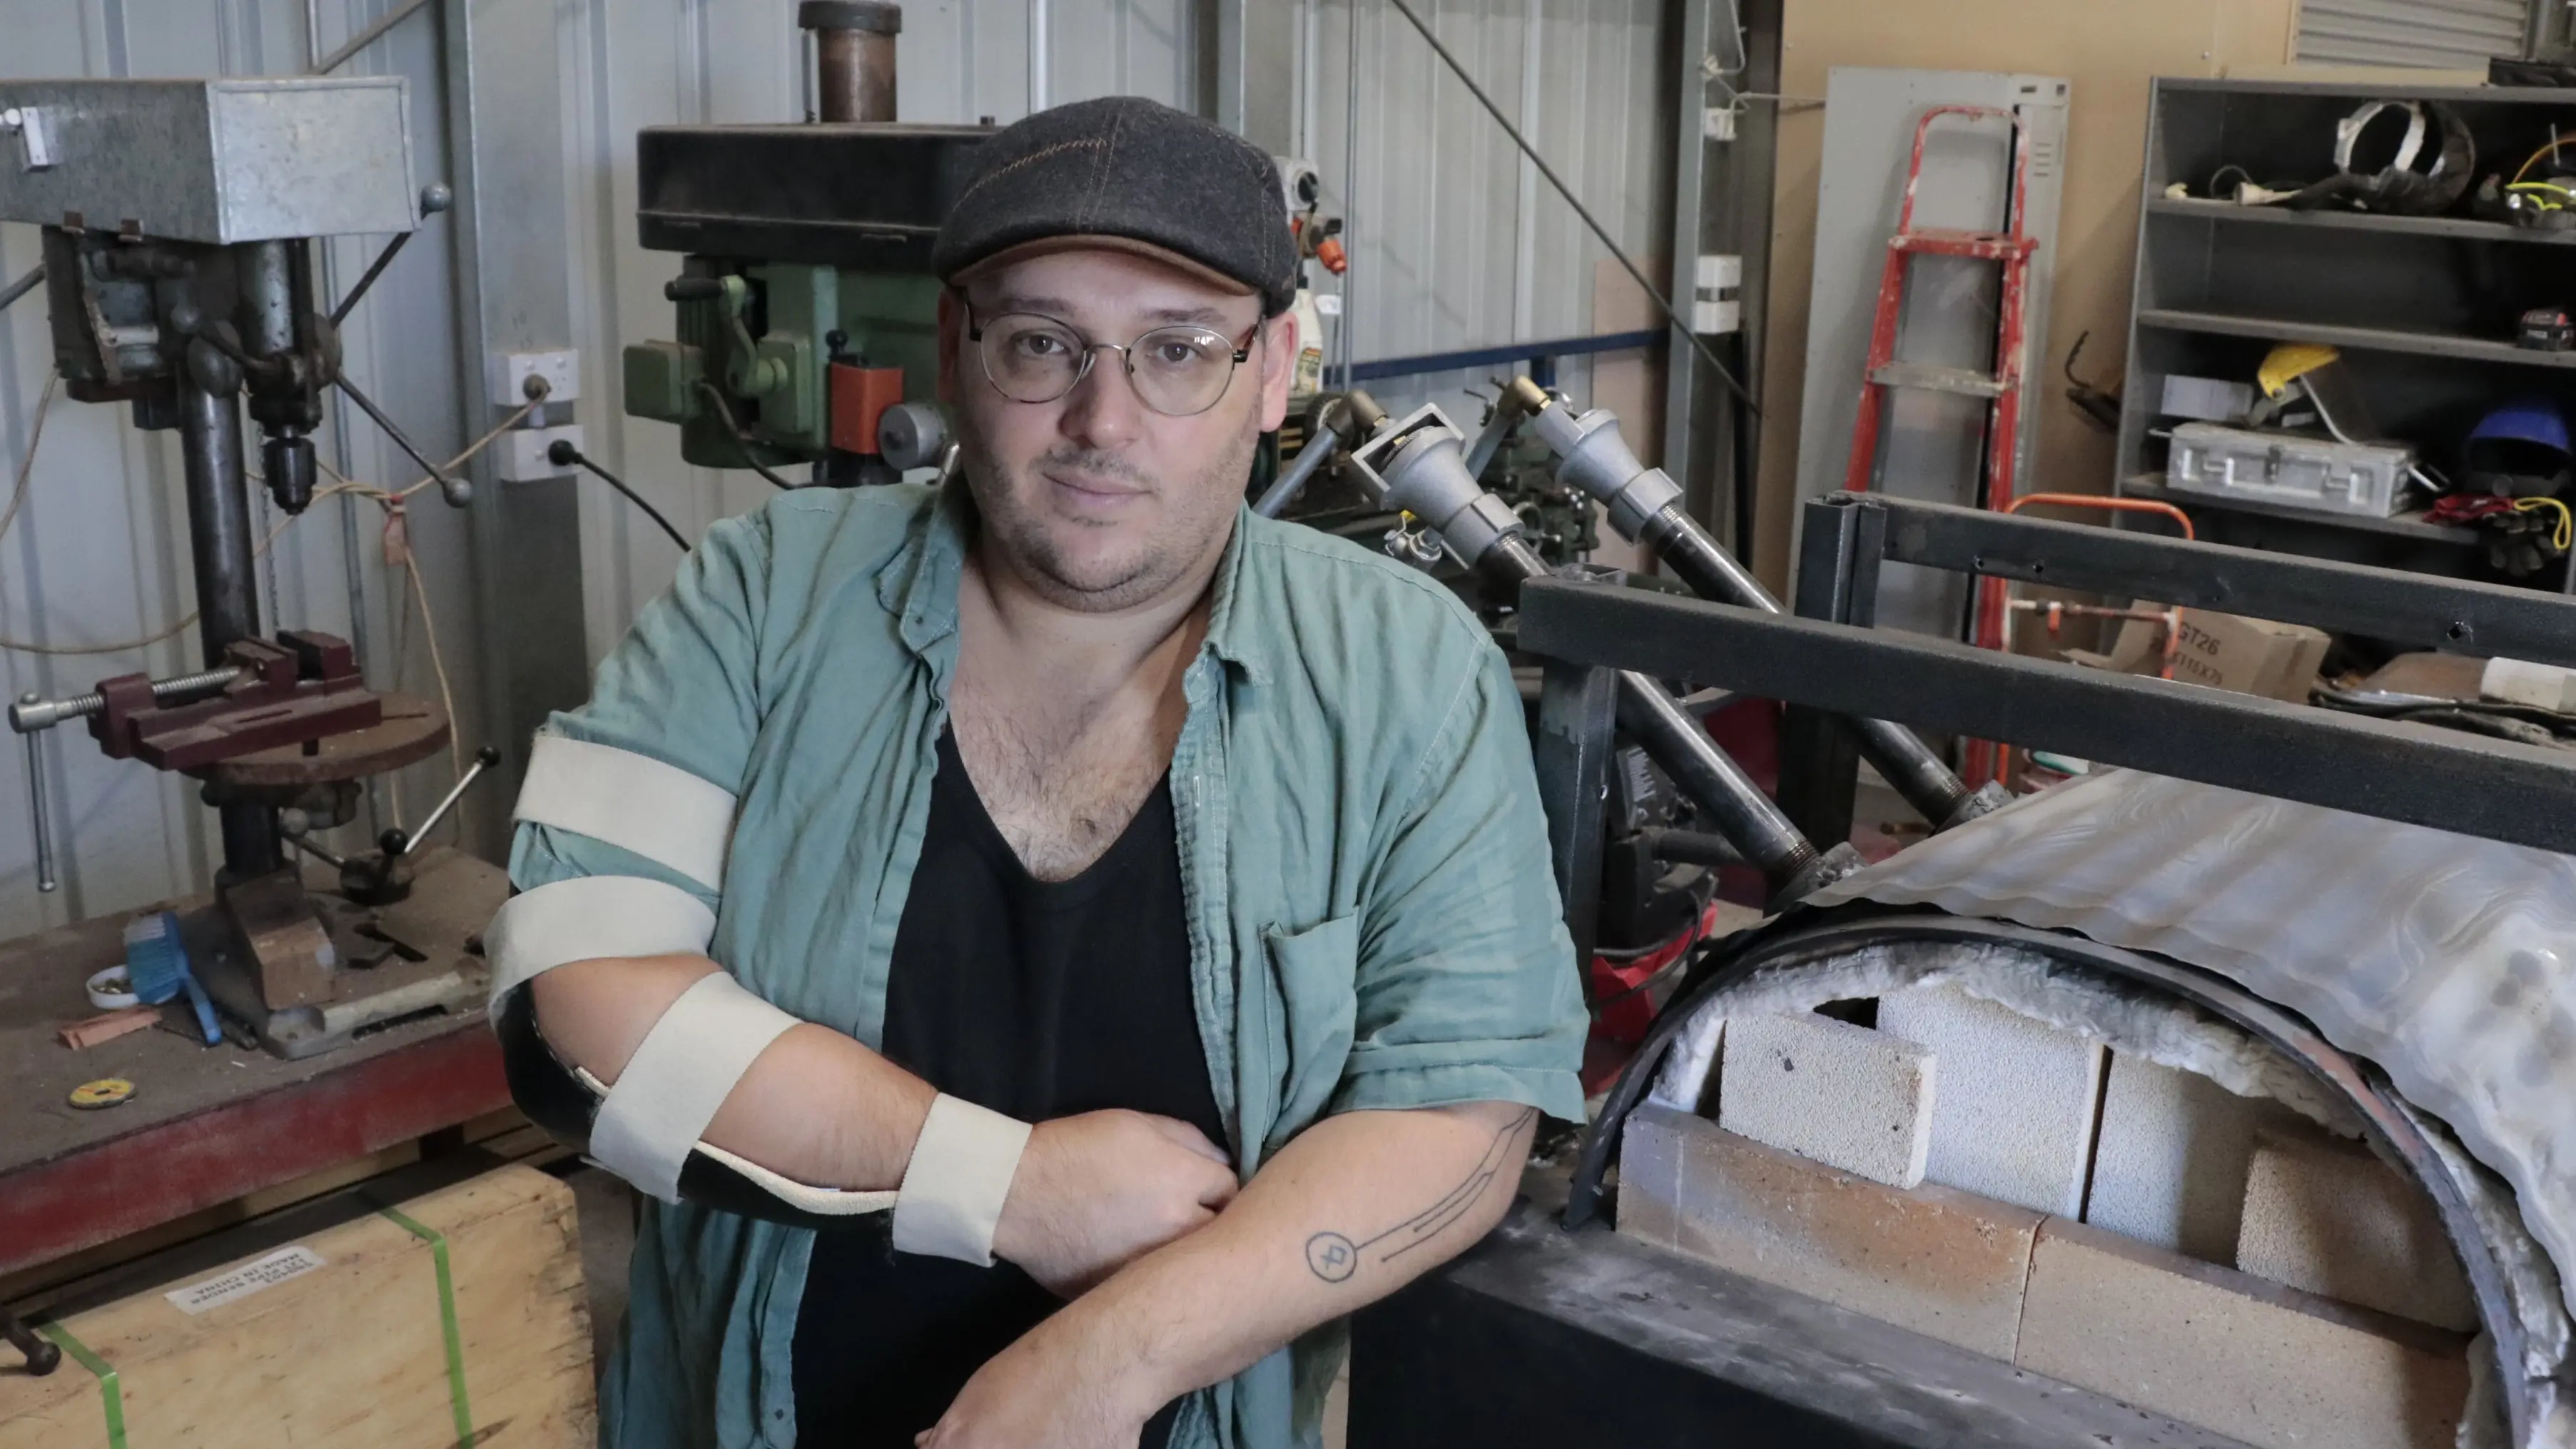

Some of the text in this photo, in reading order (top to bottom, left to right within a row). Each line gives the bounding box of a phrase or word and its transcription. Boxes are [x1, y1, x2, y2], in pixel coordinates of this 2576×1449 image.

[2179, 620, 2221, 655] GT26
[193, 1253, 300, 1296] MADE IN CHINA
[248, 1268, 280, 1283] PIPE
[191, 1282, 245, 1305] BENDER
